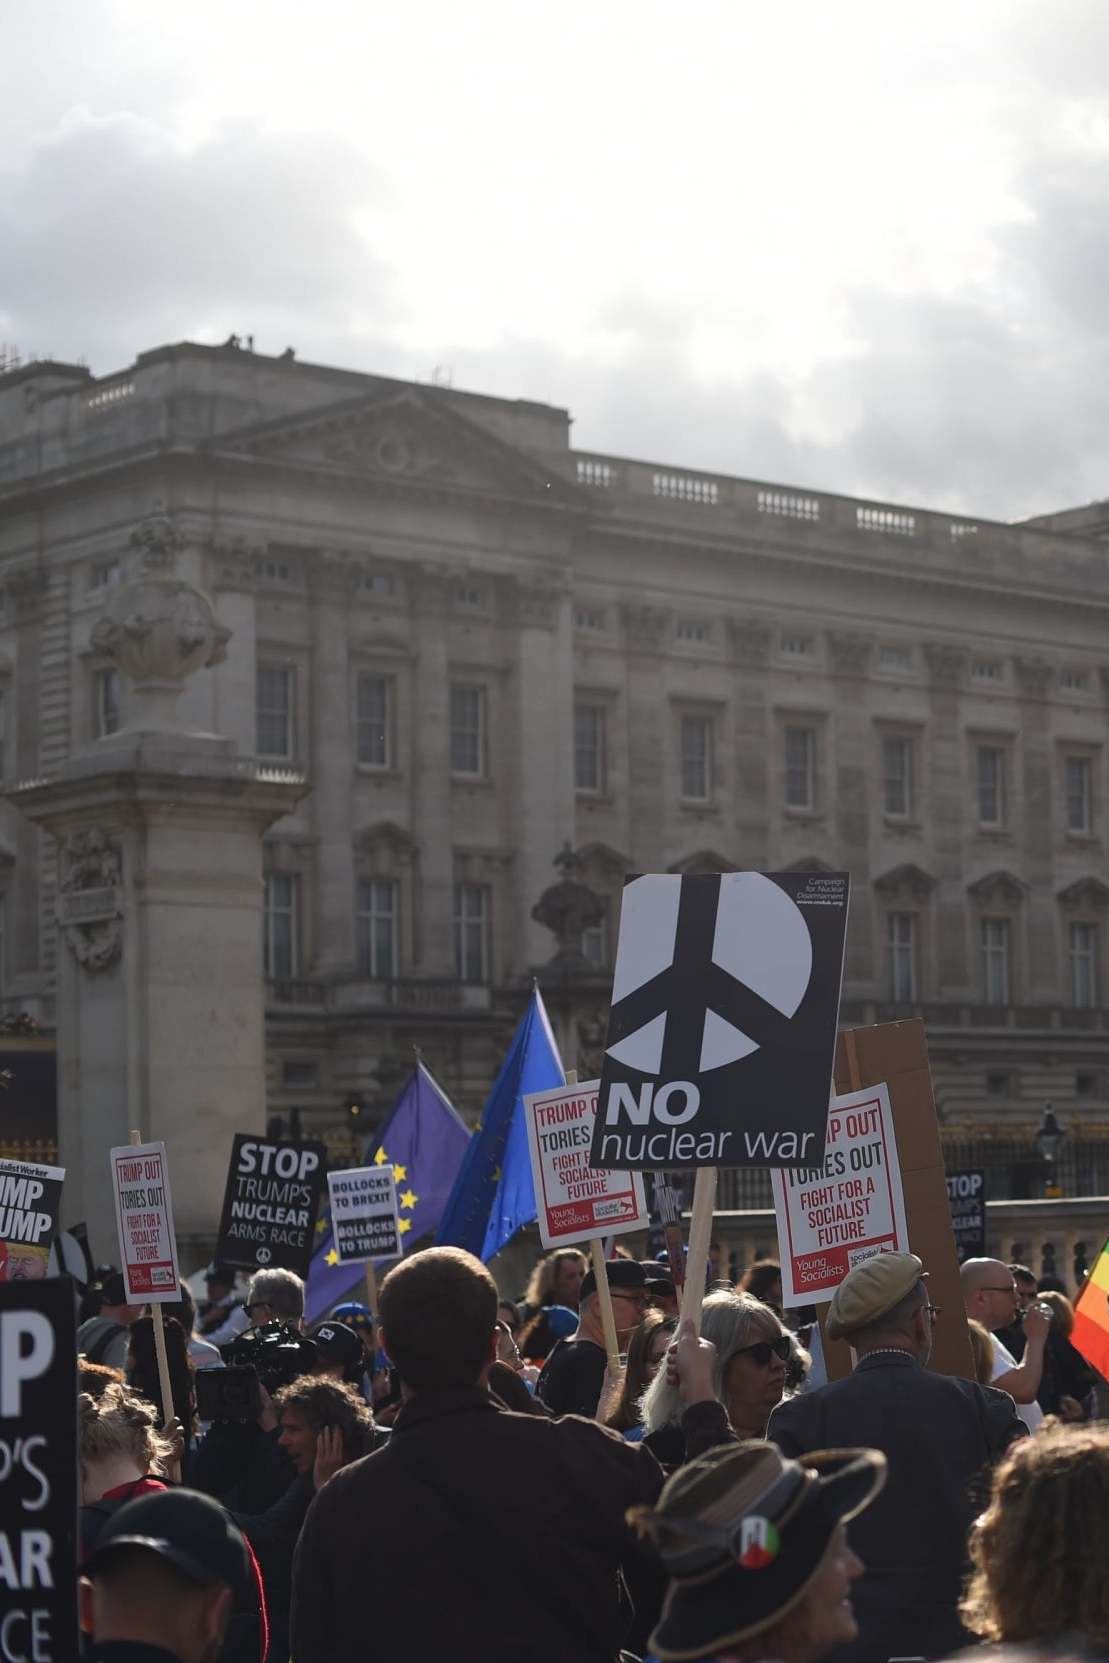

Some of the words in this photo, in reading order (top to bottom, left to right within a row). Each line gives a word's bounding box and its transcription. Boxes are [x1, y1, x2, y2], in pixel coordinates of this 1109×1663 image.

[537, 1101, 587, 1127] TRUMP
[605, 1080, 700, 1126] NO
[846, 1109, 878, 1139] OUT
[540, 1125, 590, 1153] TORIES
[601, 1127, 732, 1161] nuclear
[744, 1131, 815, 1159] war
[238, 1142, 319, 1180] STOP
[552, 1153, 581, 1171] FIGHT
[850, 1141, 882, 1171] OUT
[0, 1161, 19, 1173] ialist
[20, 1165, 48, 1177] Worker
[118, 1162, 143, 1185] TRUMP
[144, 1160, 161, 1180] OUT
[0, 1175, 44, 1210] MP
[121, 1189, 146, 1210] TORIES
[147, 1186, 163, 1208] OUT
[236, 1175, 313, 1207] TRUMP'S
[332, 1177, 391, 1194] BOLLOCKS
[567, 1179, 608, 1200] FUTURE
[800, 1185, 834, 1210] FIGHT
[838, 1179, 862, 1199] FOR
[866, 1177, 875, 1193] A
[945, 1174, 982, 1197] TOP
[335, 1197, 349, 1209] TO
[352, 1192, 391, 1206] BREXIT
[807, 1198, 871, 1228] SOCIALIST
[127, 1215, 143, 1230] FIGHT
[143, 1214, 156, 1229] FOR
[156, 1213, 162, 1227] A
[231, 1201, 310, 1228] NUCLEAR
[130, 1229, 160, 1245] SOCIALIST
[227, 1222, 267, 1243] ARMS
[270, 1228, 305, 1248] RACE
[338, 1221, 396, 1239] BOLLOCKS
[818, 1220, 866, 1247] FUTURE
[135, 1245, 160, 1261] FUTURE
[339, 1241, 355, 1253] TO
[357, 1235, 396, 1251] TRUMP
[796, 1257, 827, 1271] Young
[800, 1264, 844, 1283] Socialists
